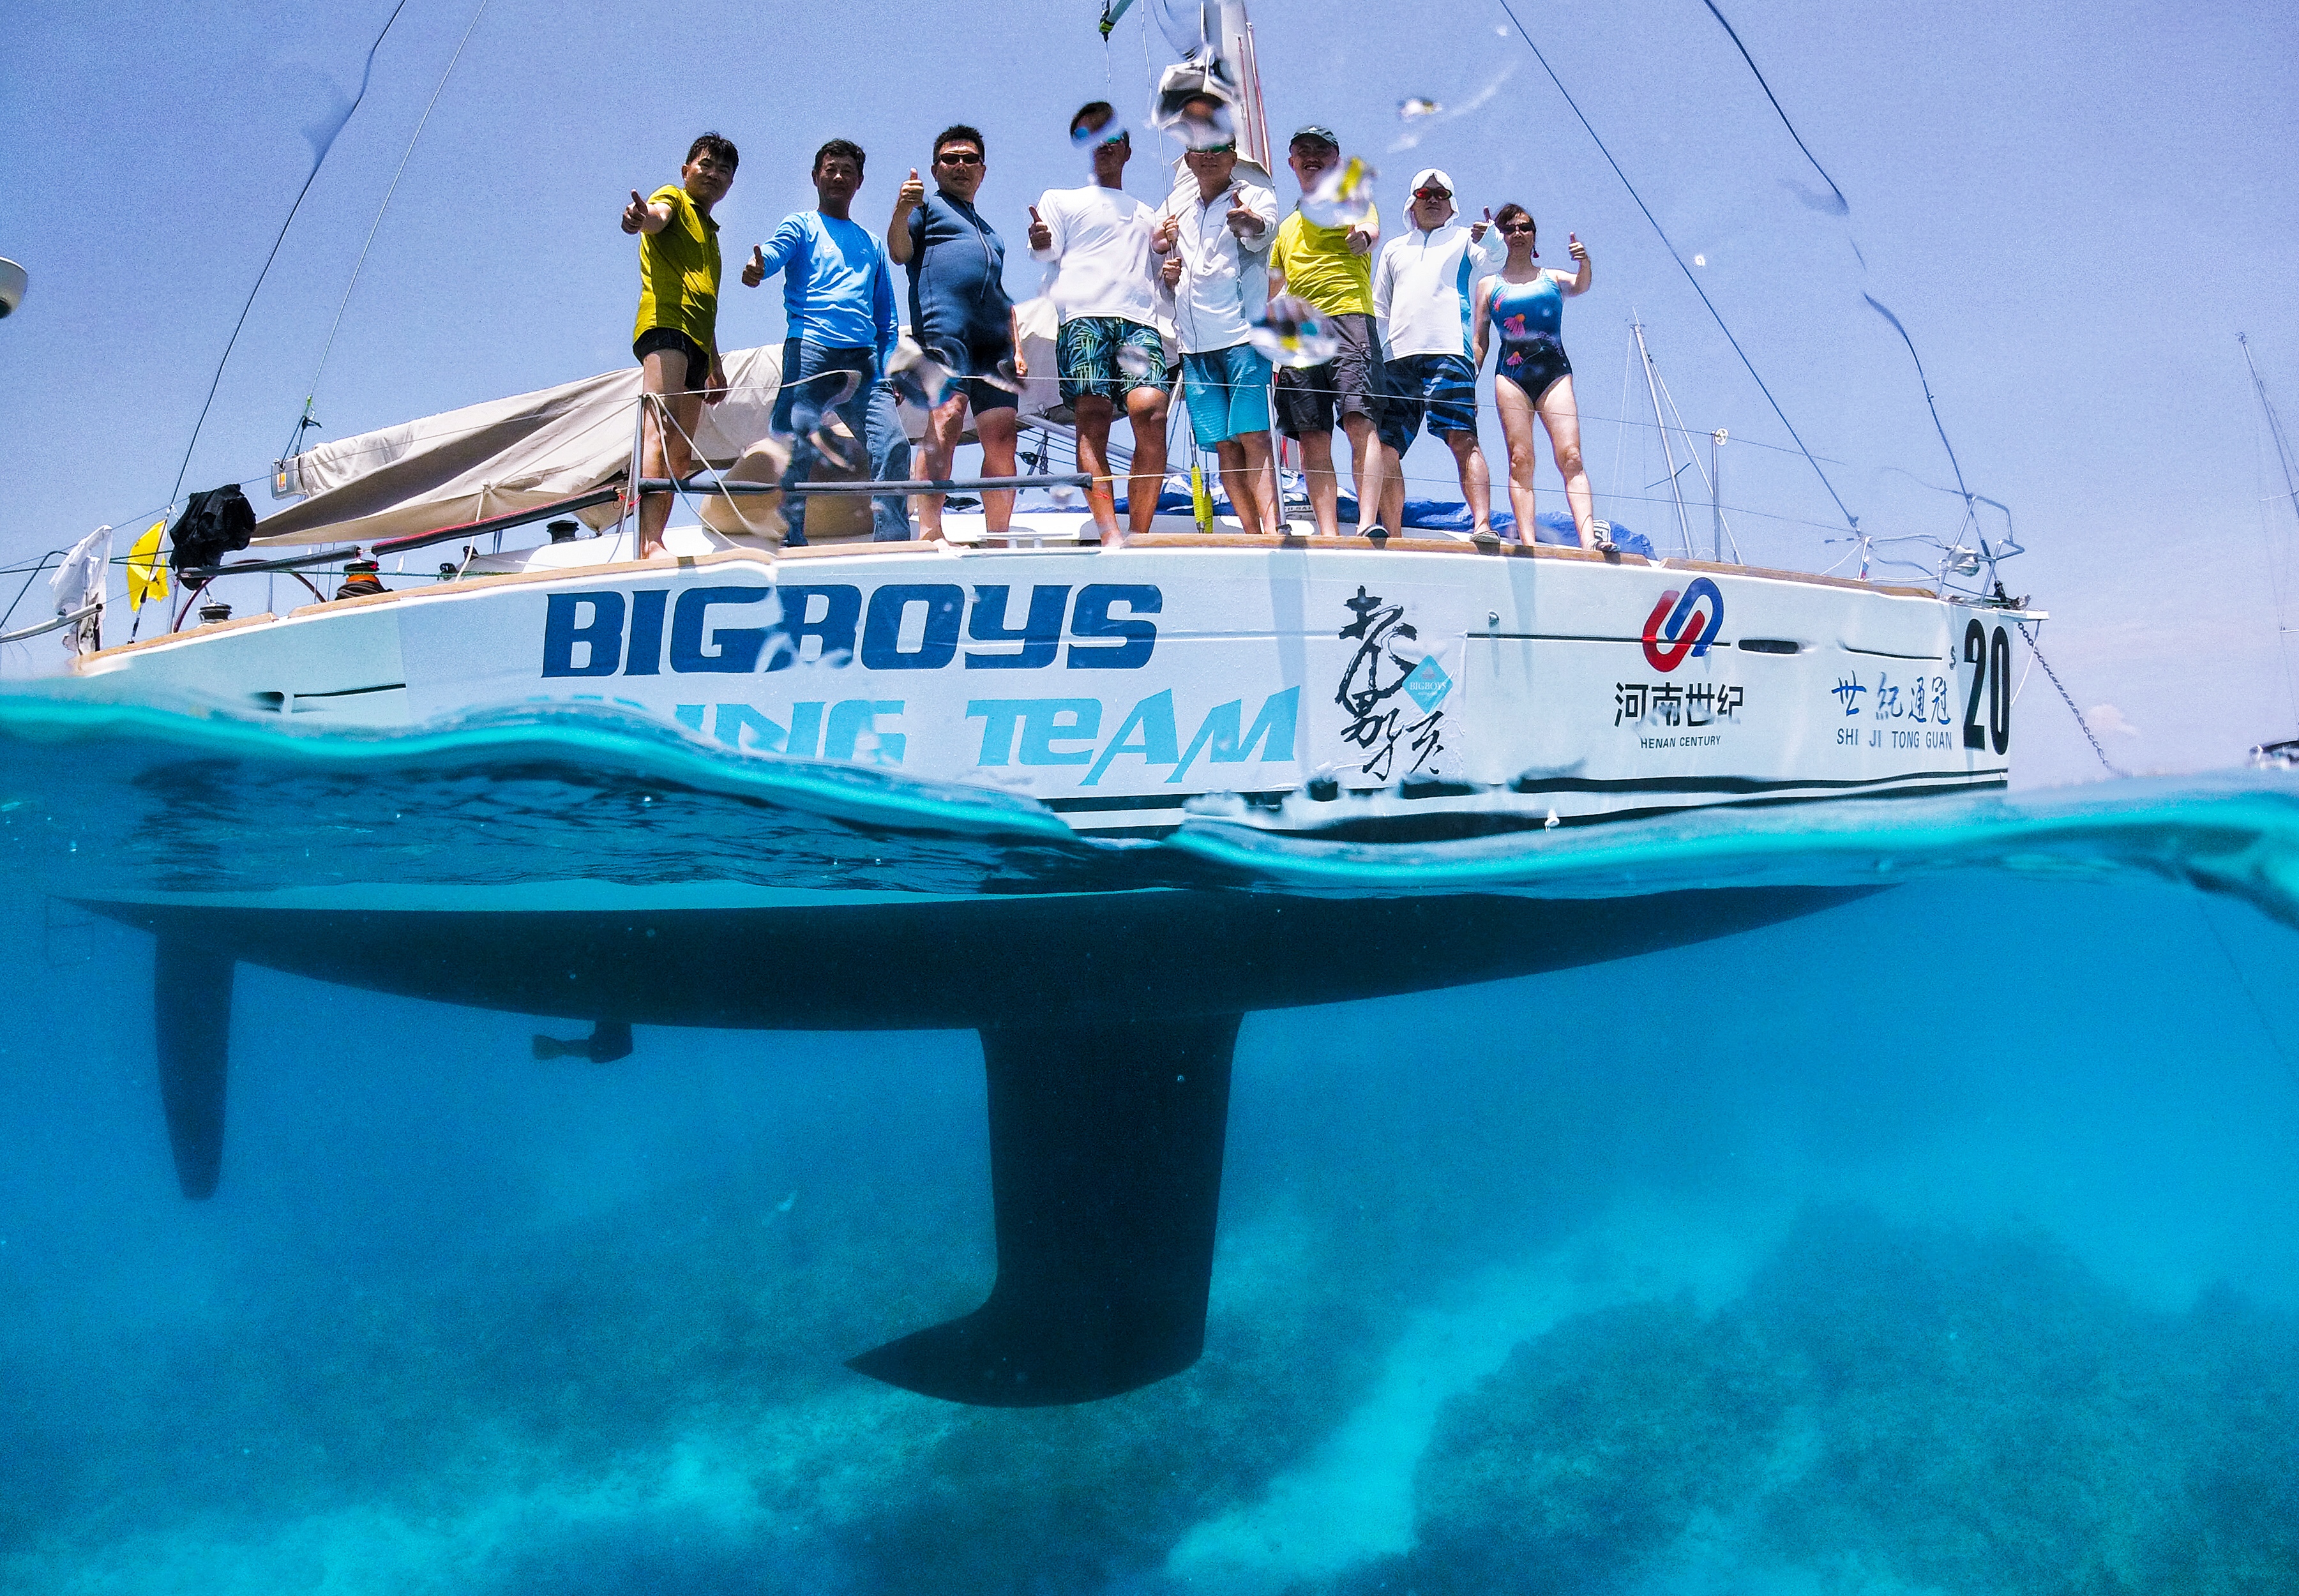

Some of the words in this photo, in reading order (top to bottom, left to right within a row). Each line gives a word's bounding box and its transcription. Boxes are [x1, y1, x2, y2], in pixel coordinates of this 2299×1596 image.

[1963, 619, 2010, 755] 20
[1614, 682, 1744, 727] 河南世纪
[1640, 737, 1676, 749] HENAN
[1680, 735, 1721, 747] CENTURY
[1837, 728, 1858, 746] SHI
[1869, 730, 1881, 748] JI
[1892, 730, 1920, 749] TONG
[1926, 731, 1952, 749] GUAN
